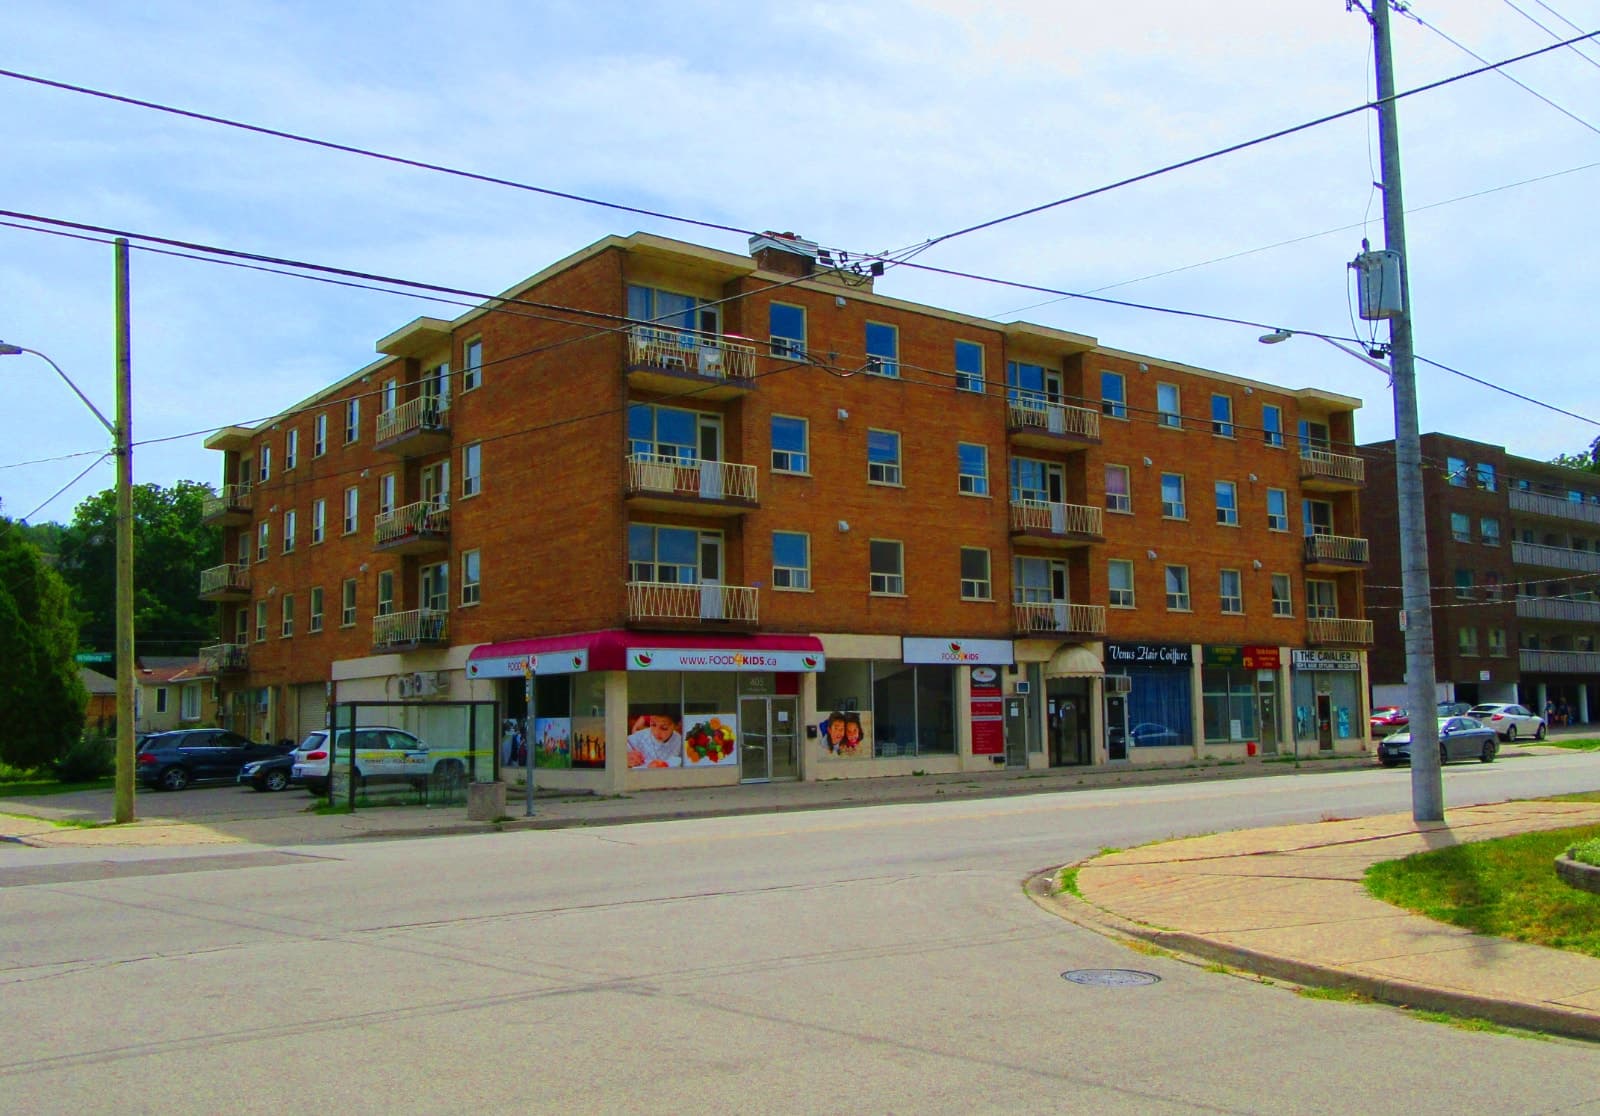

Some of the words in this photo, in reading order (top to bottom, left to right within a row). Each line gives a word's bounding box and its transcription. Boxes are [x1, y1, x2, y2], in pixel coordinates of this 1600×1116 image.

[1108, 645, 1135, 661] Venus
[1136, 646, 1158, 661] Hair
[1160, 647, 1188, 665] Coiffure
[1300, 650, 1315, 661] THE
[1317, 651, 1351, 662] CAVALIER
